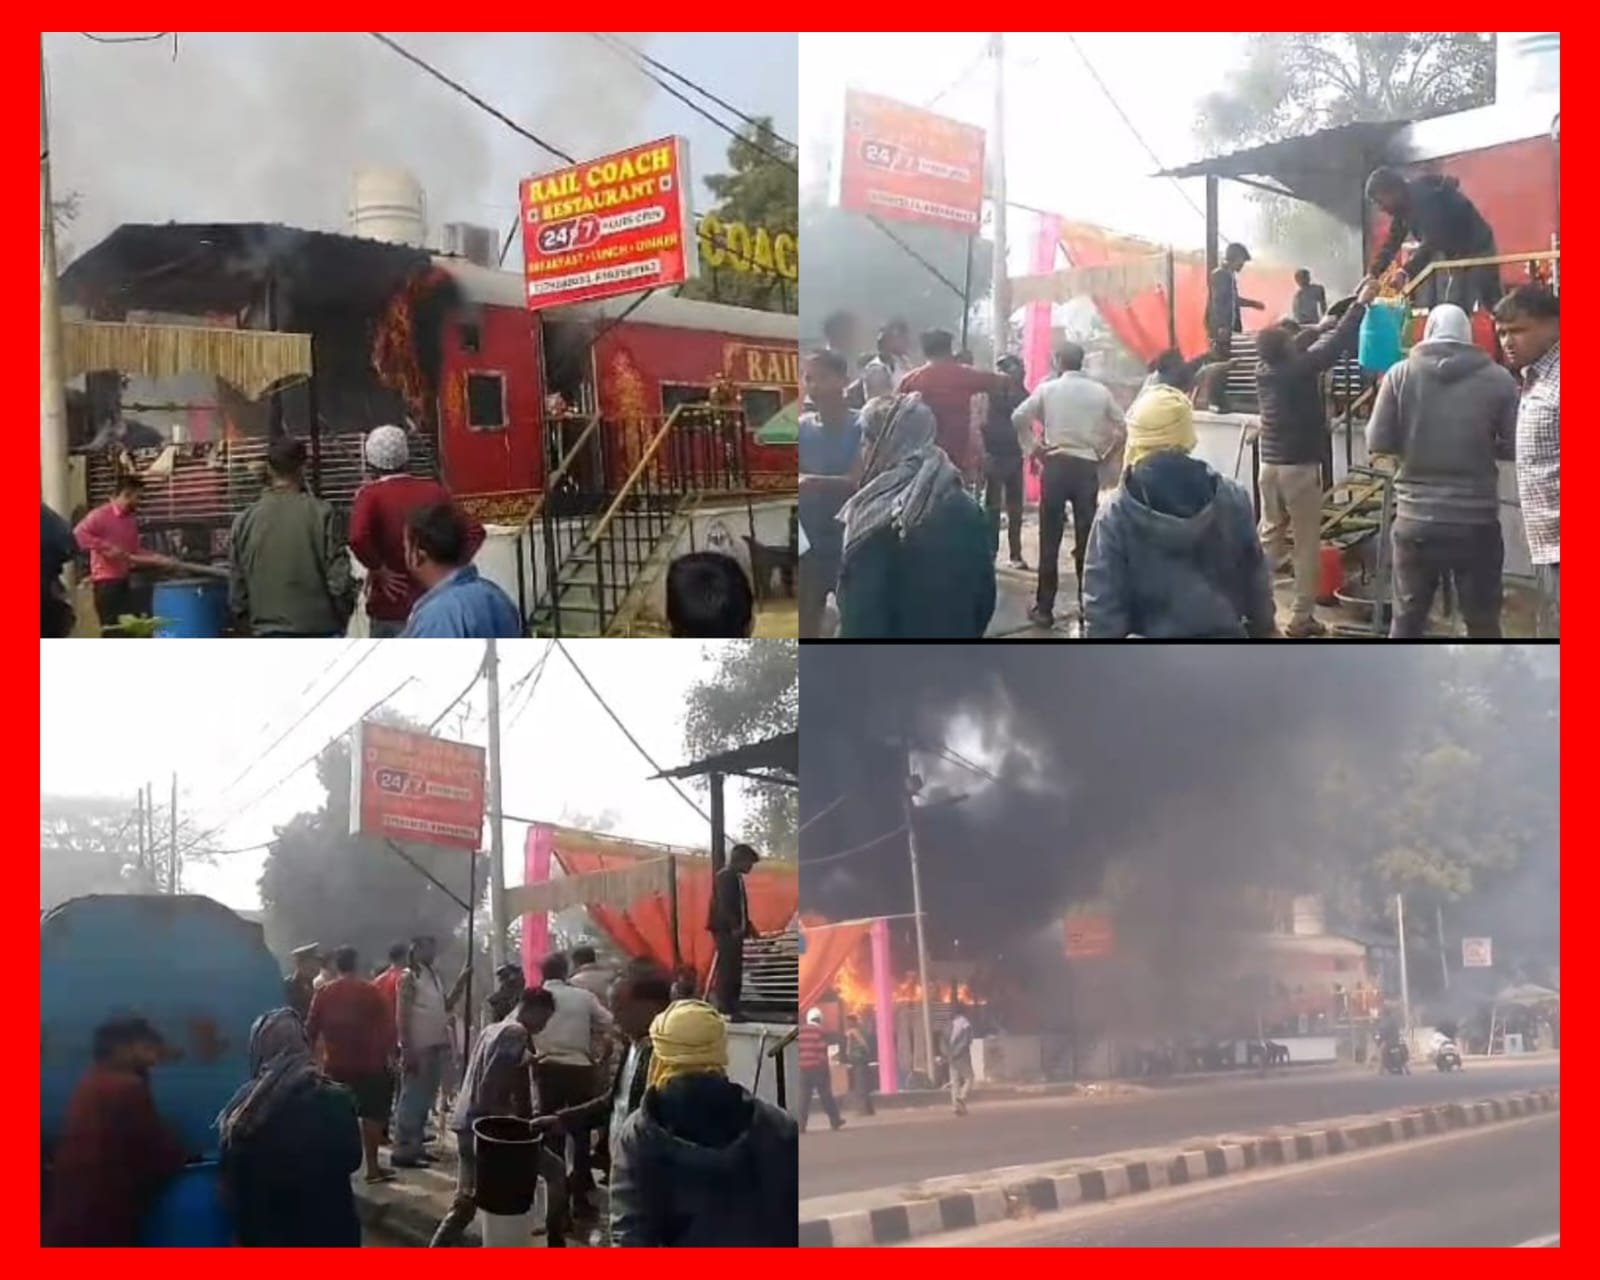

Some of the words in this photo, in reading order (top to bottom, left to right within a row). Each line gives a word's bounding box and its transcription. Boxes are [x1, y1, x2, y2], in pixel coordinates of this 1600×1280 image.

[529, 172, 582, 203] RAIL
[586, 145, 670, 188] COACH
[541, 179, 656, 220] RESTAURANT
[699, 216, 798, 280] COAC
